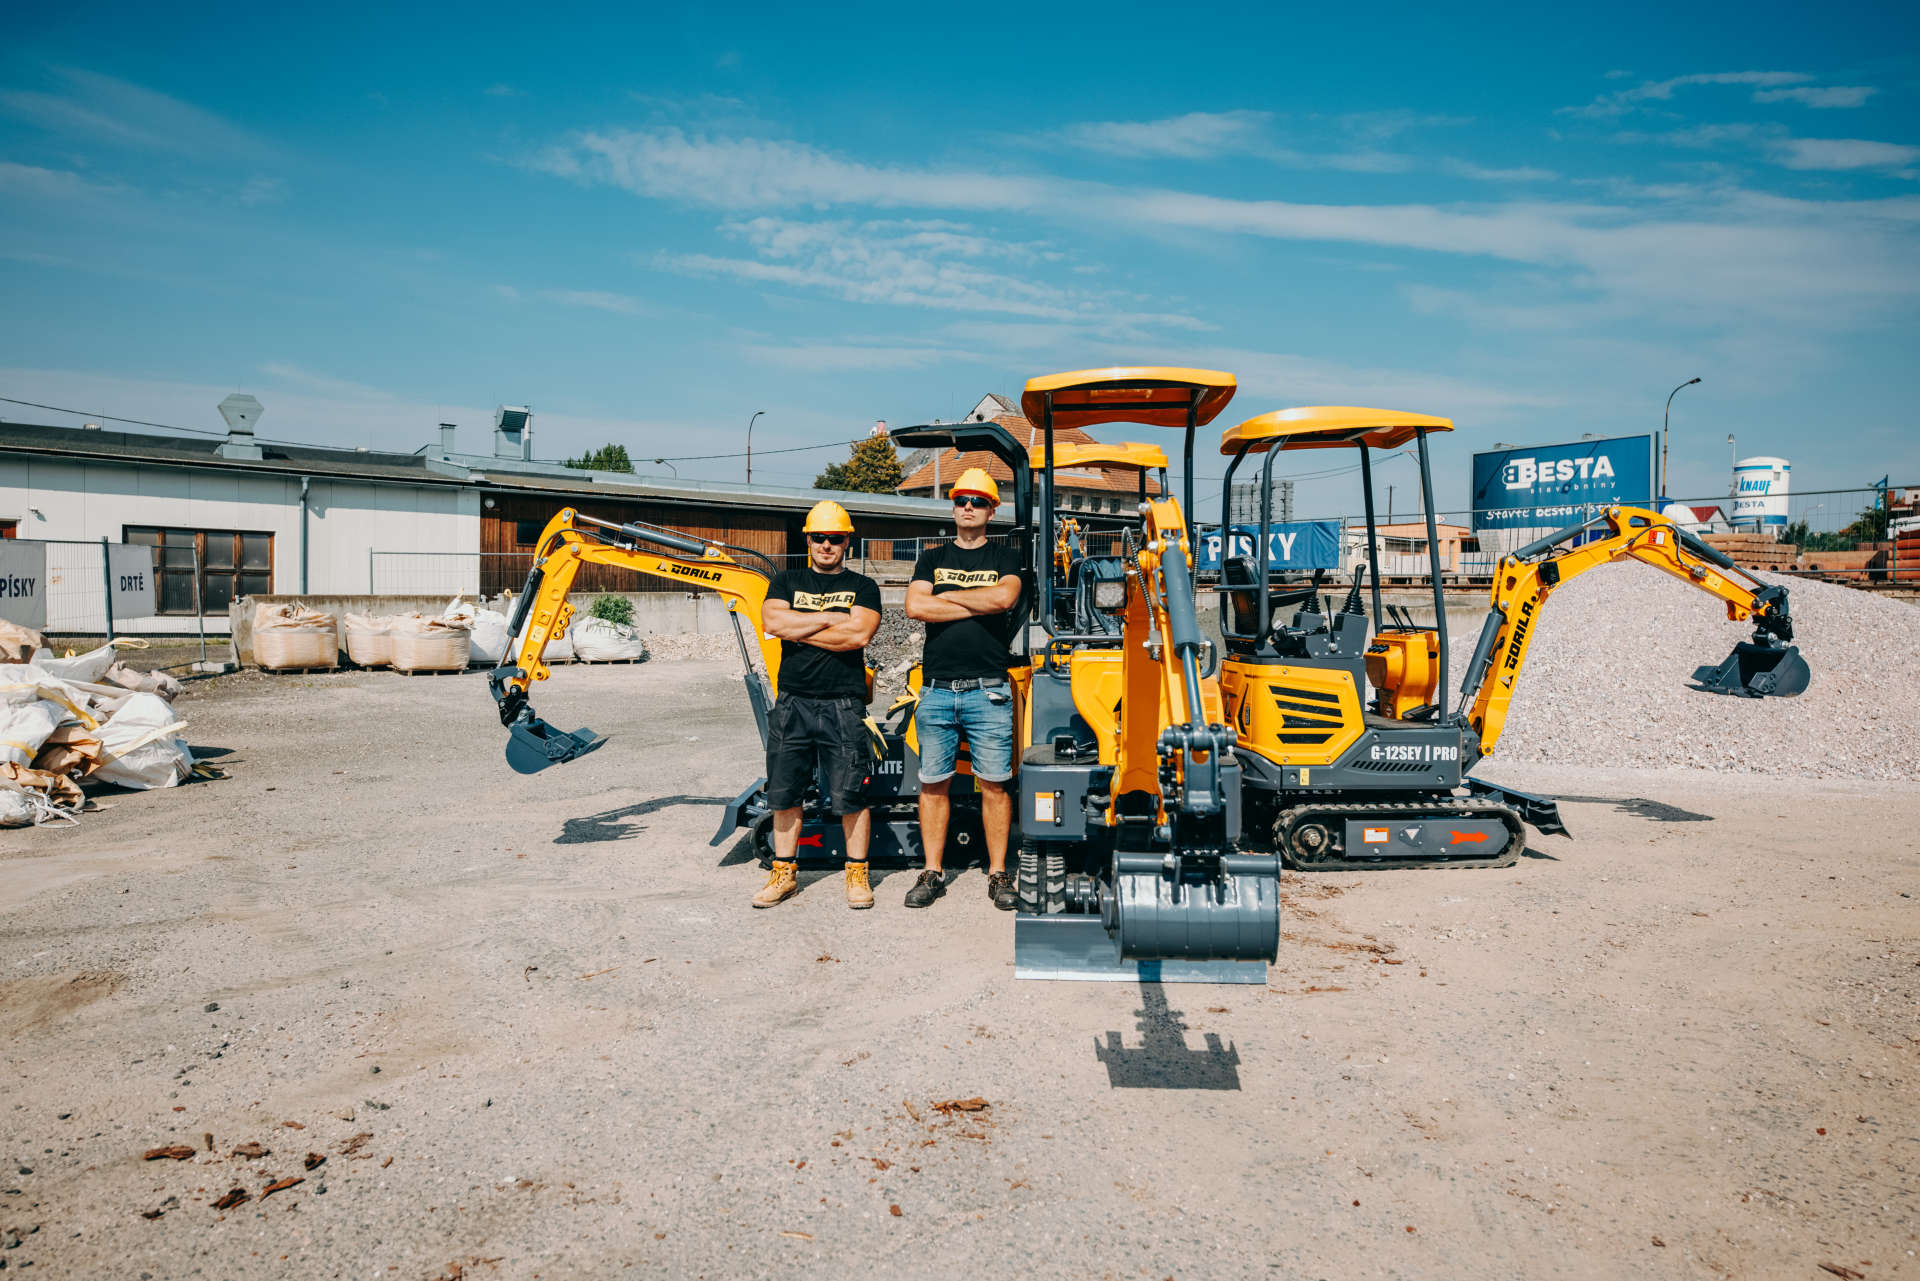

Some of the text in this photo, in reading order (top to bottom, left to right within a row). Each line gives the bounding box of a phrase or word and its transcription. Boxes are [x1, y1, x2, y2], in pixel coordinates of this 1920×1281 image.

[1503, 456, 1615, 489] BESTA
[671, 564, 722, 582] GORILA
[947, 571, 998, 583] GORILA
[0, 574, 35, 598] PÍSKY
[1504, 601, 1534, 670] GORILA
[1371, 745, 1422, 760] G-12SEY
[1433, 746, 1458, 761] PRO
[878, 760, 903, 775] LITE
